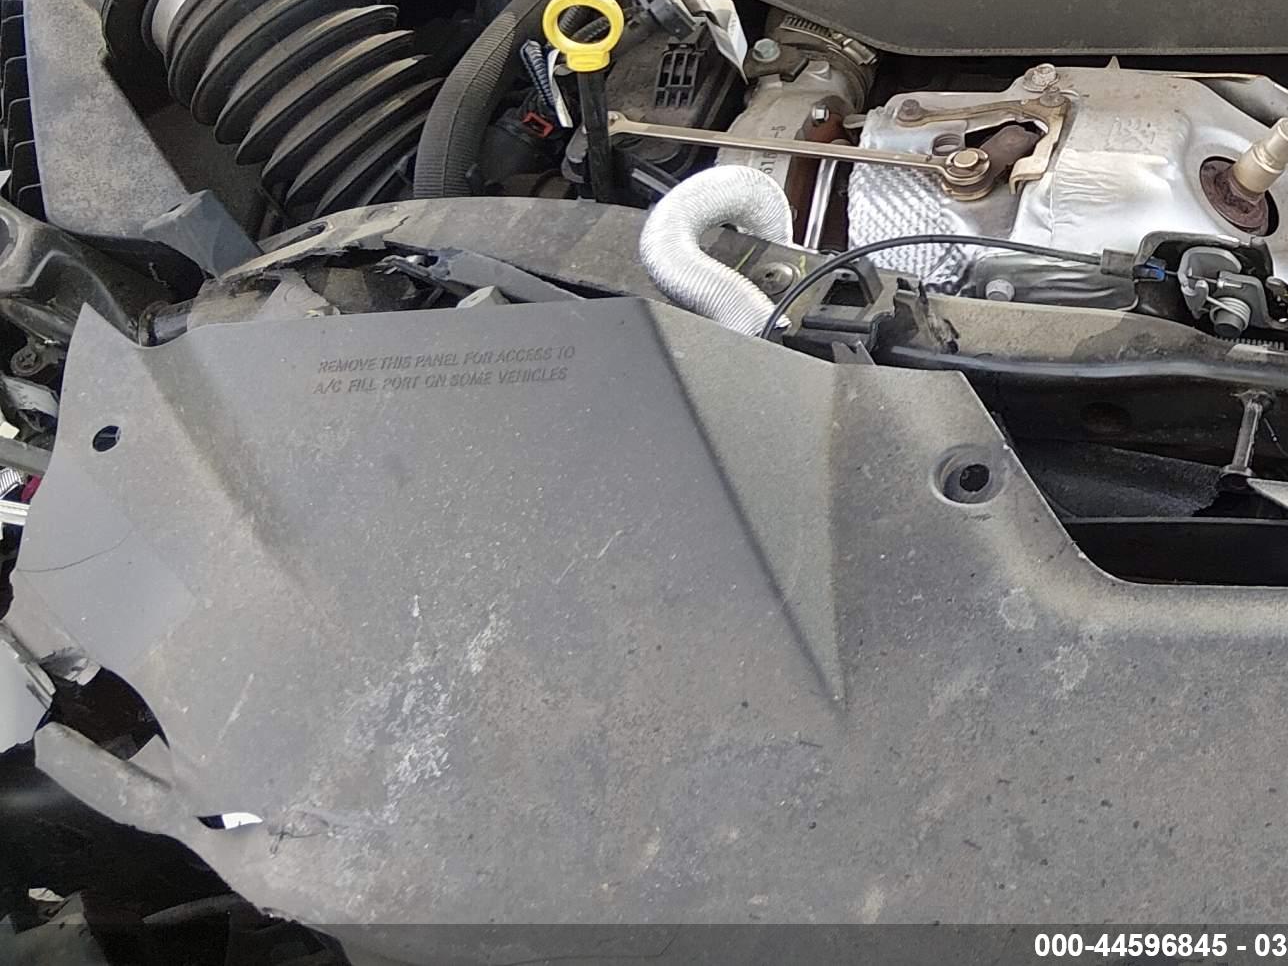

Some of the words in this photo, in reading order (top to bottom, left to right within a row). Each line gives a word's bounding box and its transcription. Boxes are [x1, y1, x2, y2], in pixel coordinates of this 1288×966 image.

[318, 357, 378, 374] REMOVE
[380, 355, 412, 370] THIS
[414, 352, 459, 368] PANEL
[463, 350, 494, 365] FOR
[495, 346, 552, 363] ACCESS
[554, 344, 576, 360] TO
[313, 377, 343, 394] A/C
[347, 377, 377, 393] FILL
[382, 375, 421, 390] PORT
[424, 373, 449, 388] ON
[450, 371, 493, 387] SOME
[498, 366, 568, 384] VEHICLES
